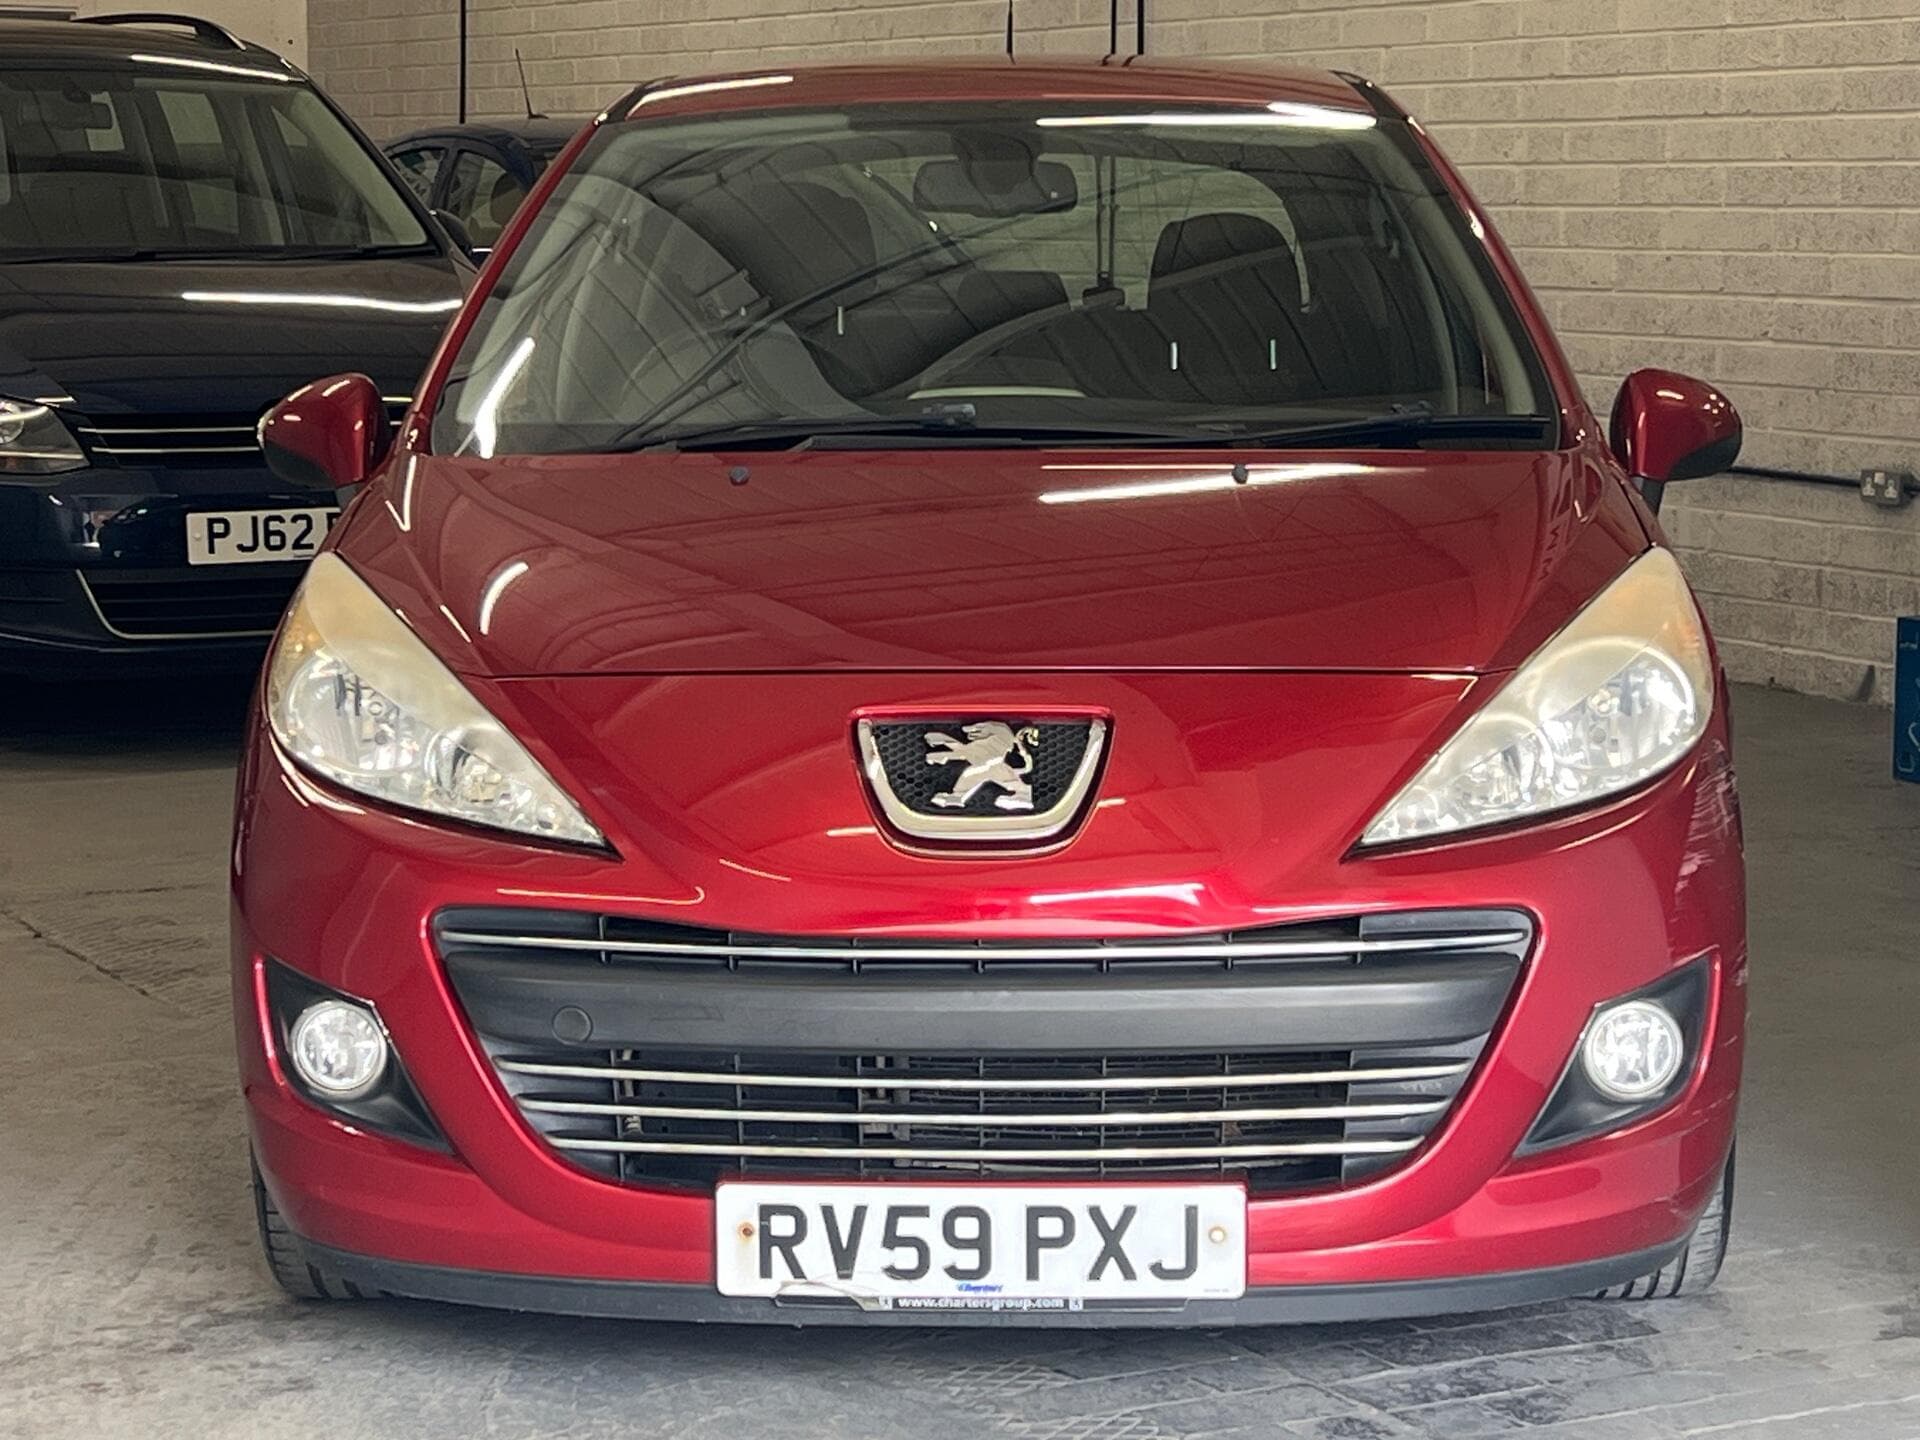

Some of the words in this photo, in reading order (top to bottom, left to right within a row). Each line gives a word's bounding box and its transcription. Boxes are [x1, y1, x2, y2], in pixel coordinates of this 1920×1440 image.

[207, 514, 314, 554] PJ62
[759, 1203, 991, 1280] RV59
[1026, 1203, 1198, 1280] PXJ
[898, 1297, 1065, 1311] www.chartersgroup.com
